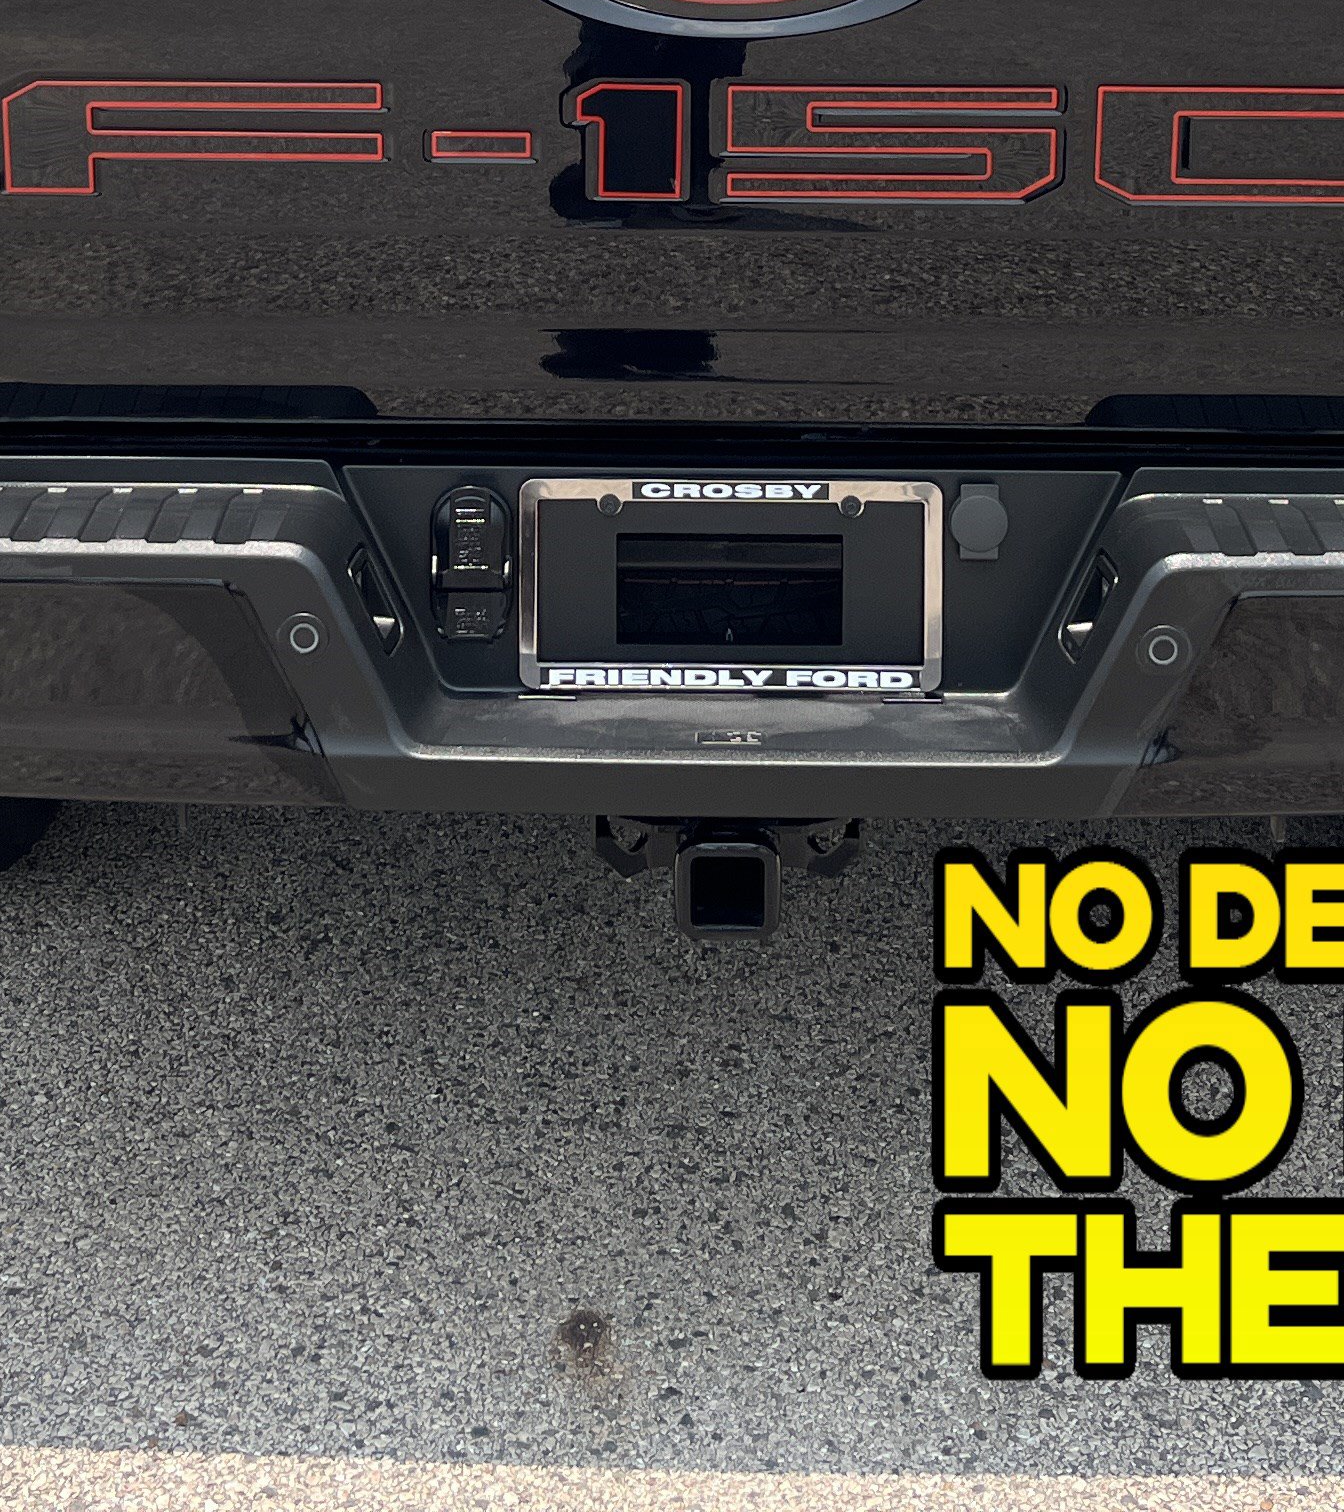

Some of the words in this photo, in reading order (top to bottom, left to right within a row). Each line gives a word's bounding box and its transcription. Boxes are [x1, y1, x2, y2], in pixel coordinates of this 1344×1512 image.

[640, 483, 822, 500] CROSBY
[548, 668, 773, 687] FRIENDLY
[786, 670, 914, 688] FORD
